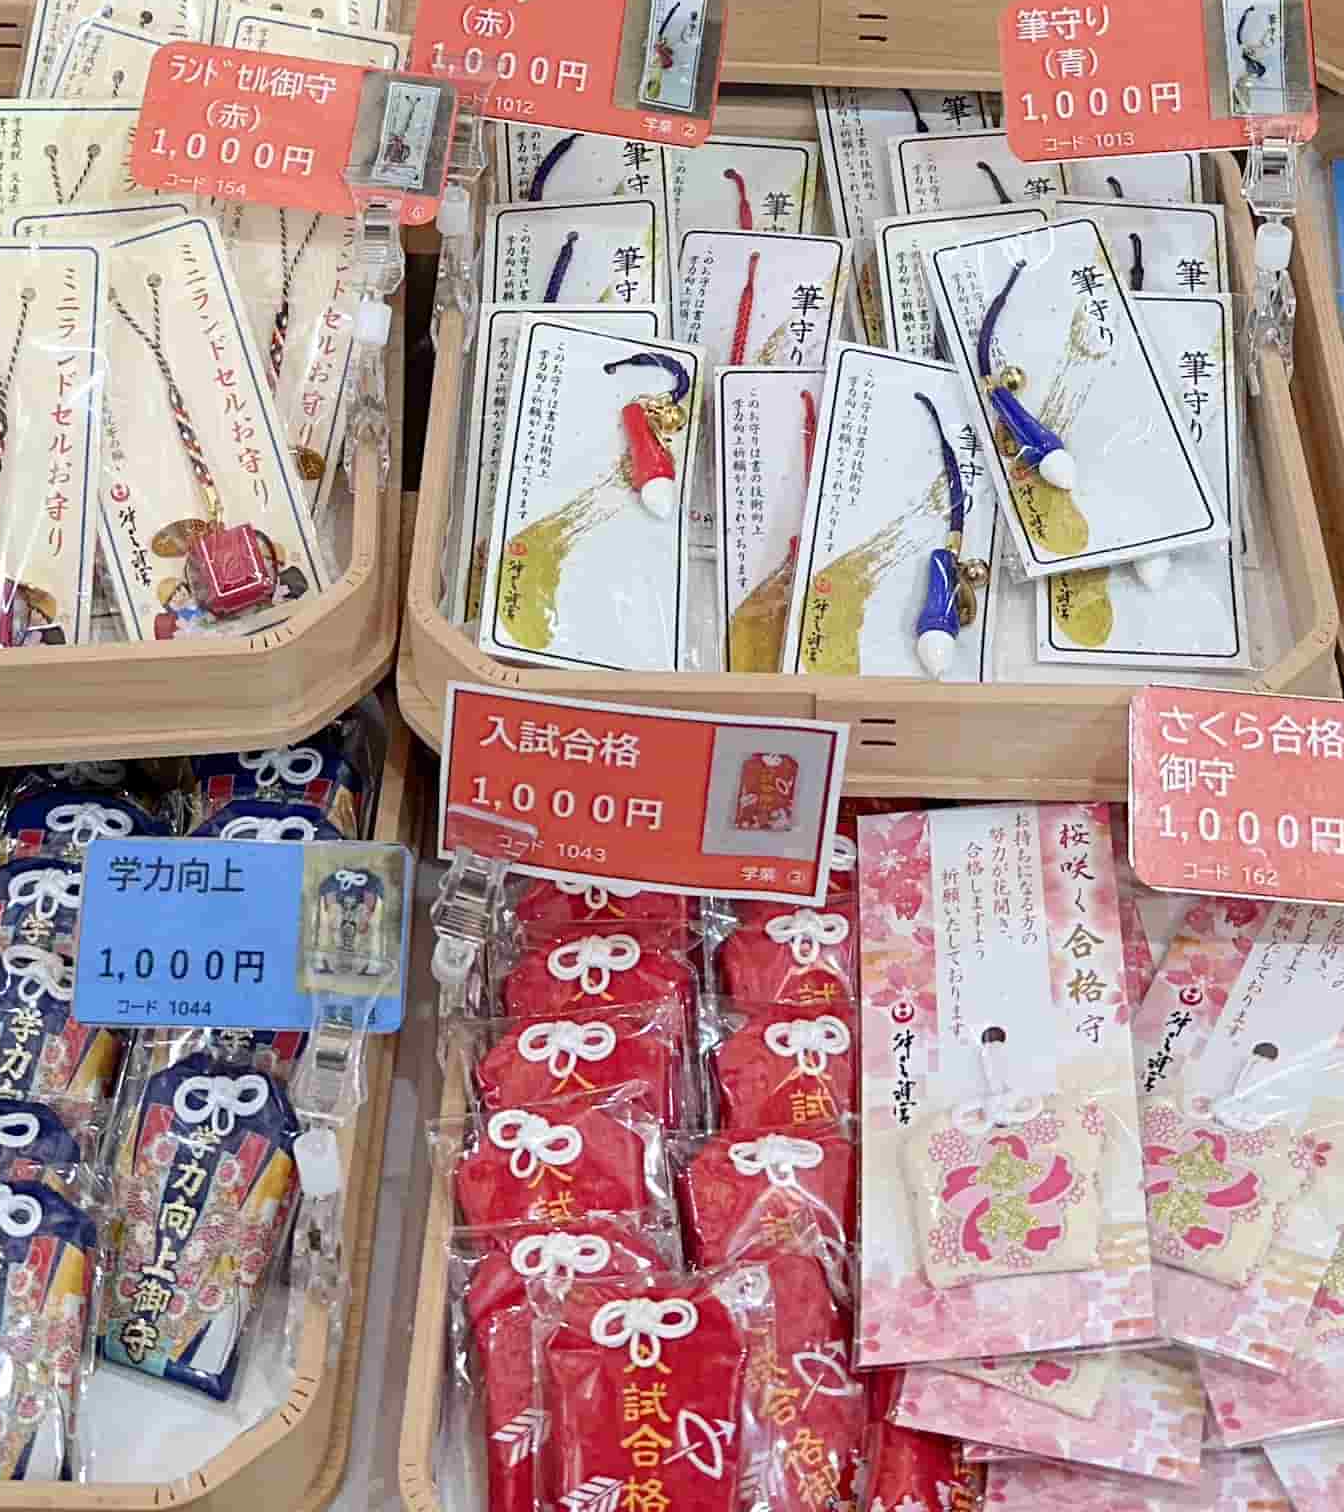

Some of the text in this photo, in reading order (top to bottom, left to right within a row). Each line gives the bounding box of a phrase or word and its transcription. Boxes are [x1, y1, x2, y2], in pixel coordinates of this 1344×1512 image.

[461, 5, 516, 39] （赤）
[1016, 5, 1112, 44] 筆守り
[431, 40, 589, 93] 1,000円
[1044, 46, 1099, 80] （青）
[205, 99, 263, 134] （赤）
[495, 95, 537, 114] 1012
[1020, 81, 1183, 124] 1,000円
[151, 127, 316, 177] 1,000円
[1044, 131, 1136, 152] コード 1013
[215, 178, 247, 196] 154
[1071, 263, 1114, 346] 筆守り
[789, 286, 824, 367] 筆守り
[178, 243, 271, 510] ミニランドセルお守り
[1178, 350, 1212, 444] 筆守り
[46, 268, 81, 557] ミニランドセルお守り
[479, 715, 641, 769] 入試合格
[1158, 752, 1237, 798] 御守
[470, 775, 665, 832] 1,000円
[497, 833, 608, 862] コード 1043
[107, 856, 246, 894] 学力向上
[1183, 862, 1281, 888] コード 162
[98, 949, 266, 984] 1,000円
[115, 999, 212, 1016] コード 1044
[119, 1125, 220, 1362] 学力向上御守
